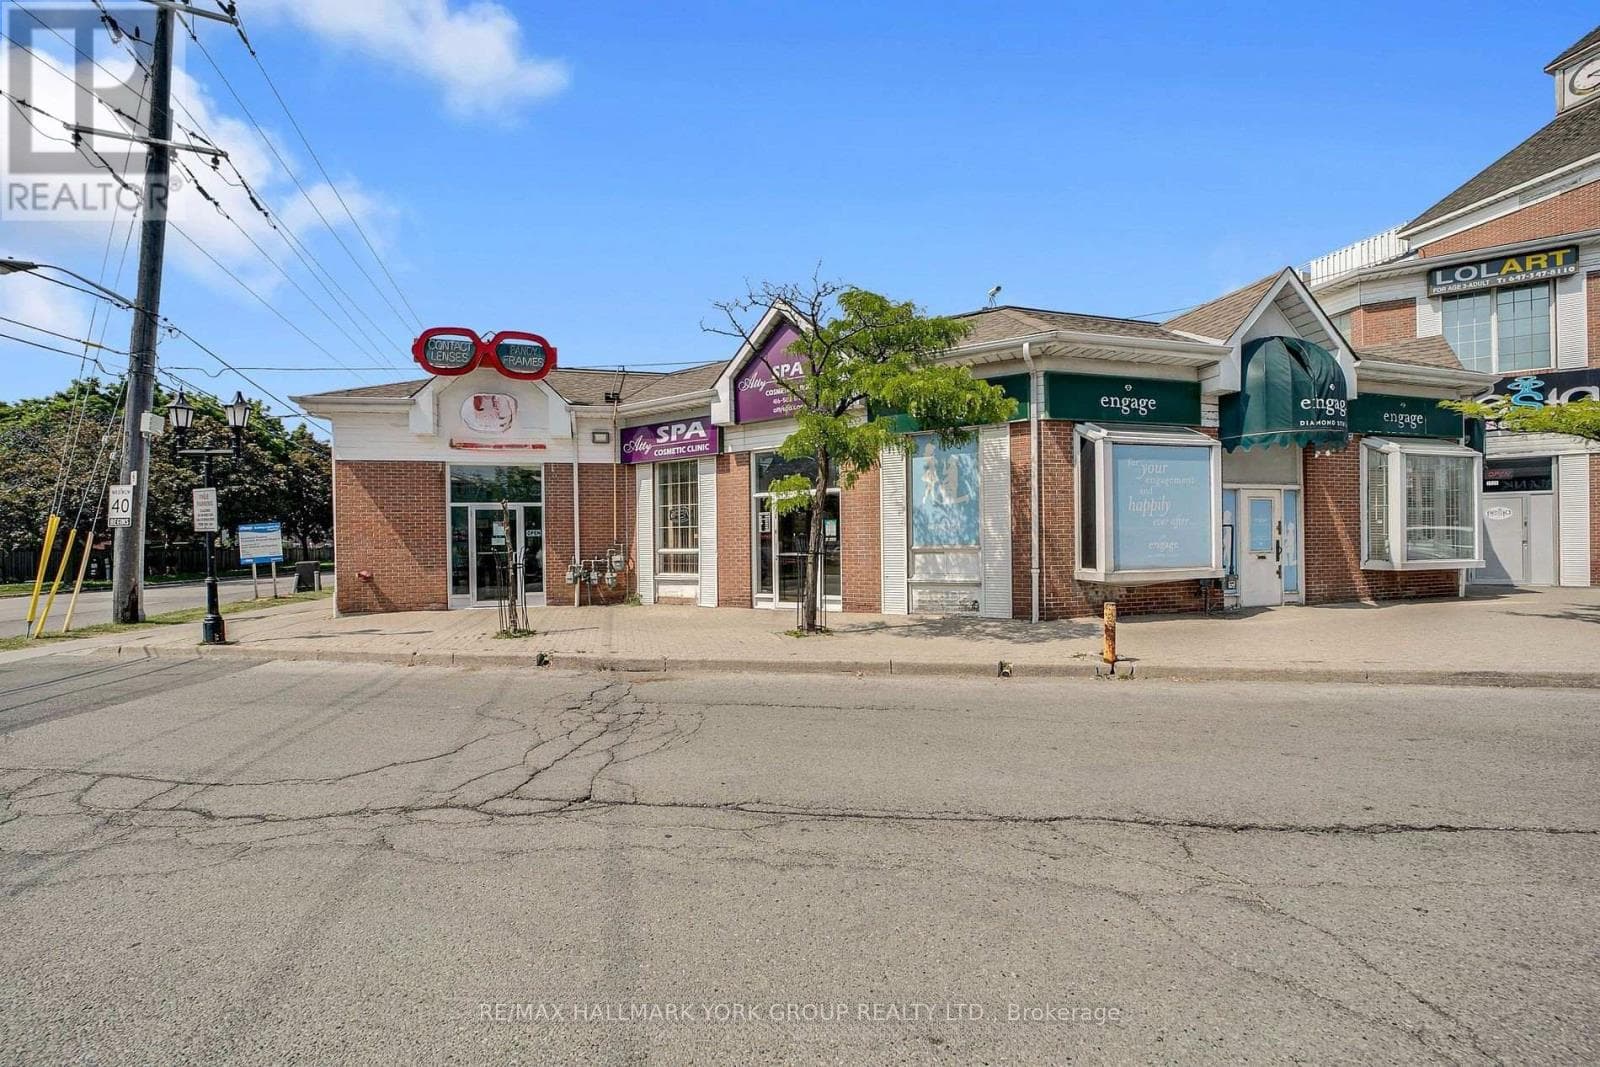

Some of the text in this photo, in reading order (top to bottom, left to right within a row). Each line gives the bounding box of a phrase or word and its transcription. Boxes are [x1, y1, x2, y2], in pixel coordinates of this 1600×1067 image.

[428, 340, 473, 351] CONTACT
[430, 351, 468, 363] LENSES
[503, 355, 545, 367] FRAMES
[771, 361, 804, 380] SPA
[1100, 396, 1157, 416] engage
[1300, 397, 1347, 417] engag
[1383, 411, 1424, 428] engage
[656, 421, 707, 444] SPA
[653, 443, 710, 457] COSMETIC CLINIC
[1136, 463, 1168, 480] your
[112, 499, 130, 513] 40
[1128, 496, 1172, 516] happily
